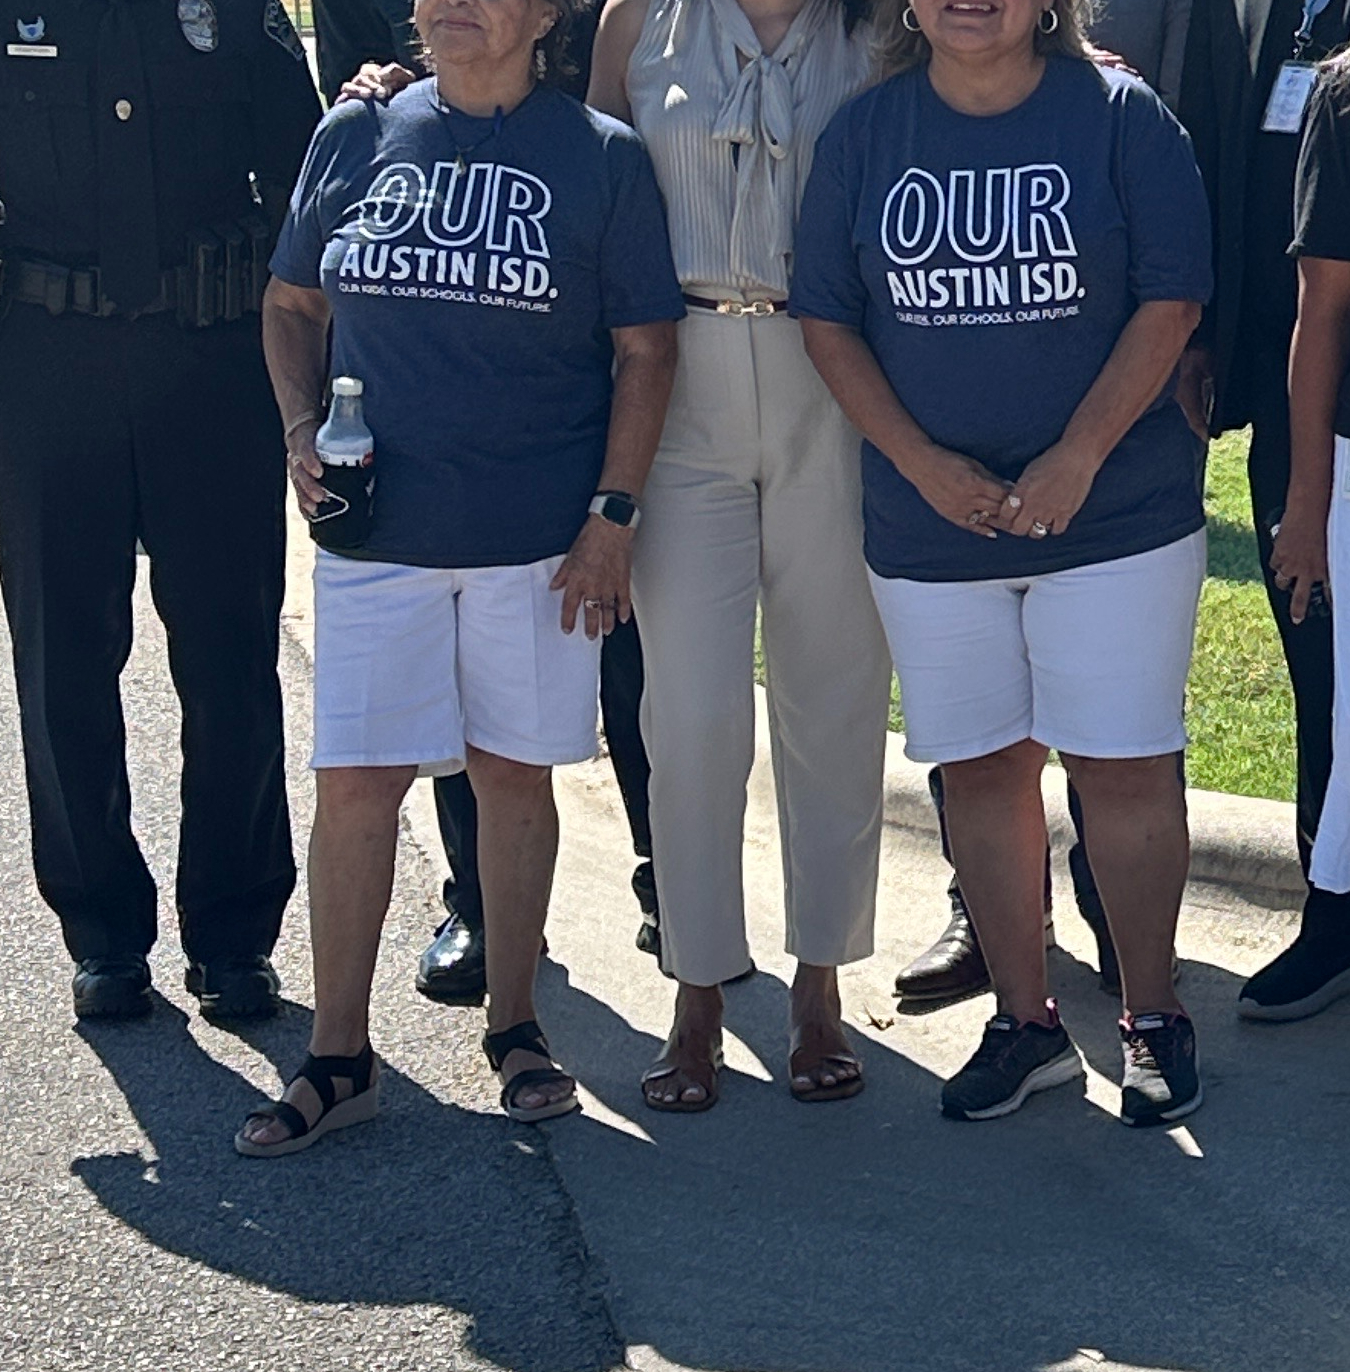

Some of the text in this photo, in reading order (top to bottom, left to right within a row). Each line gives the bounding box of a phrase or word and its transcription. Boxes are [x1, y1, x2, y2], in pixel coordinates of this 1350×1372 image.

[359, 161, 552, 259] OUR
[881, 163, 1078, 265] OUR
[338, 242, 559, 299] AUSTIN ISD.
[886, 262, 1085, 308] AUSTIN ISD.
